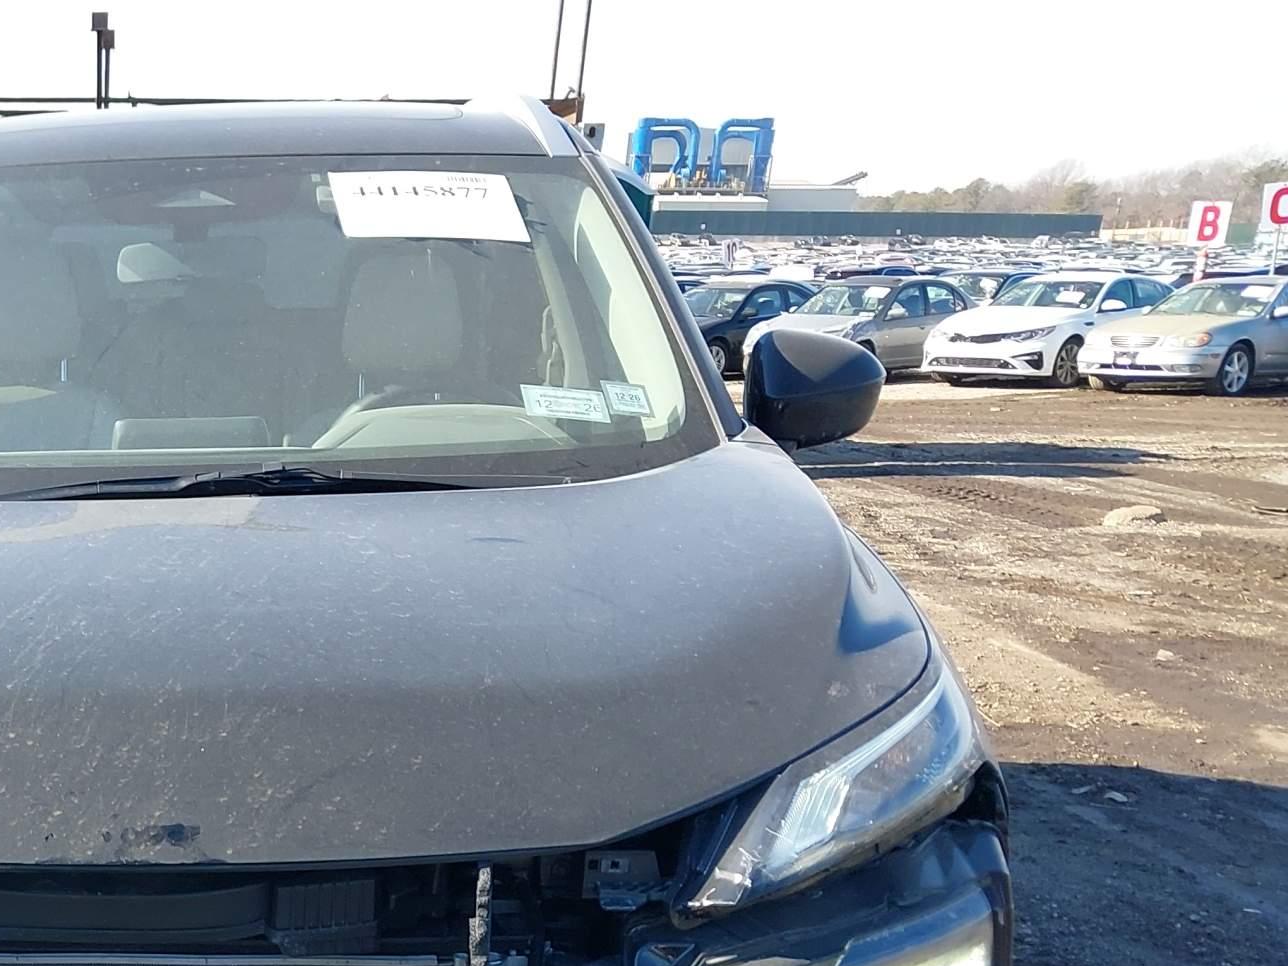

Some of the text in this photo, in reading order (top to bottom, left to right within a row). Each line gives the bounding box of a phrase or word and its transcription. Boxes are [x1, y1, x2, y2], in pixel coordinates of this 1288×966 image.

[352, 185, 488, 201] 44145877
[1196, 205, 1221, 242] B
[535, 399, 553, 409] 12
